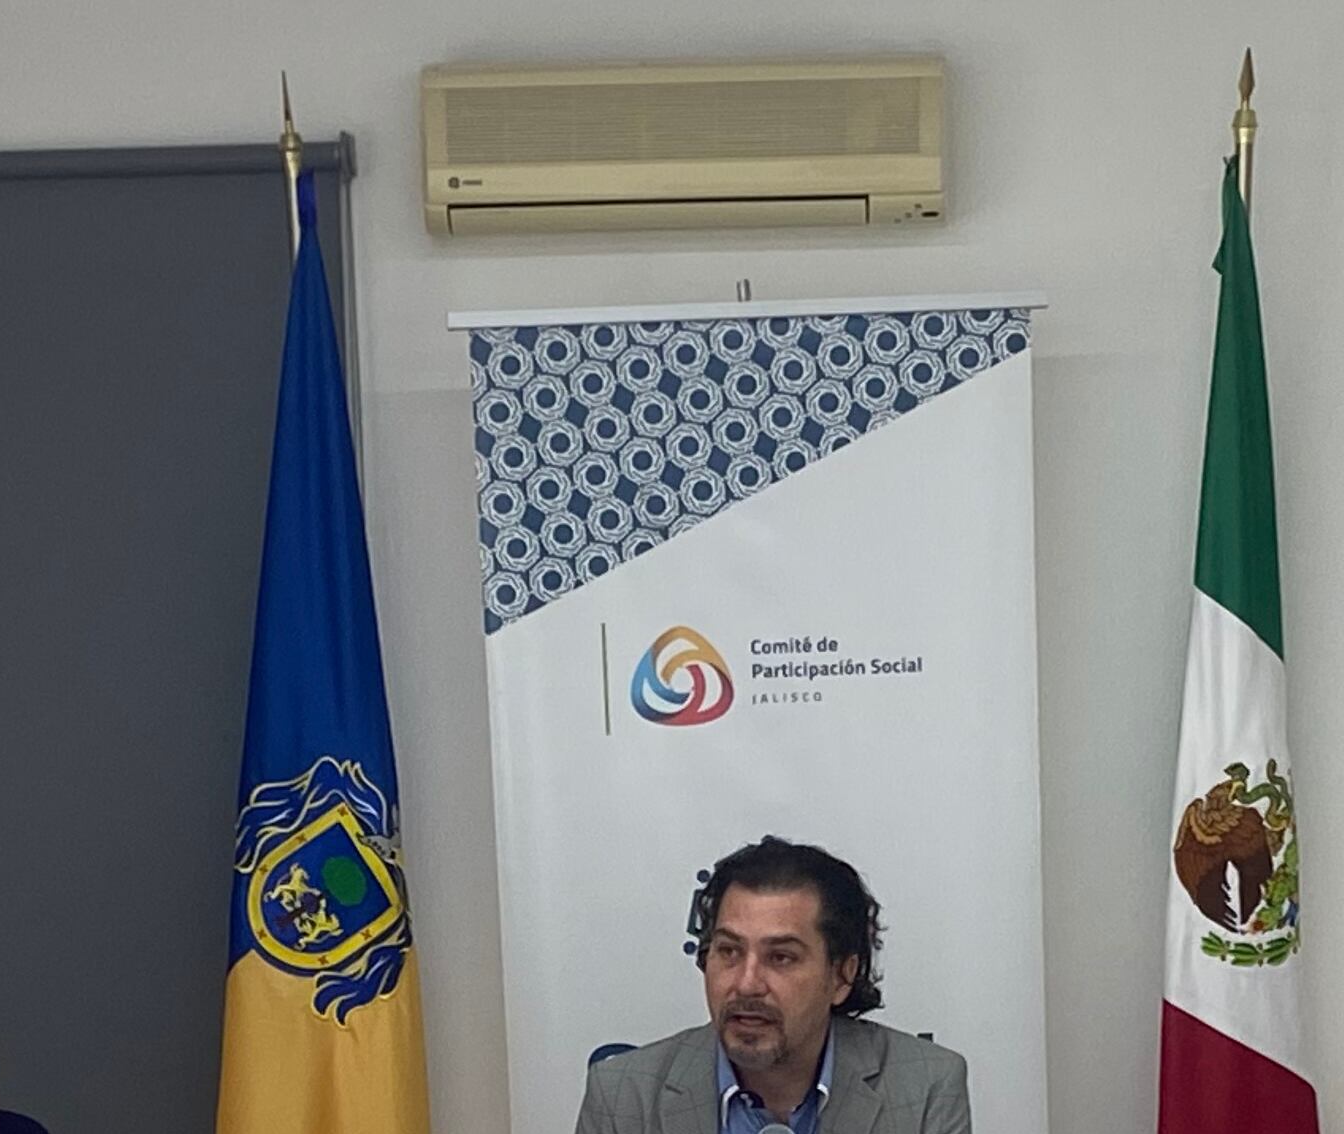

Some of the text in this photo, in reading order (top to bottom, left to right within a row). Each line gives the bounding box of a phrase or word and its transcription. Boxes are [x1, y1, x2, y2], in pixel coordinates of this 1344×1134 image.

[751, 636, 838, 655] Comité de
[752, 656, 922, 681] Participación Social
[752, 691, 823, 705] JALISCO
